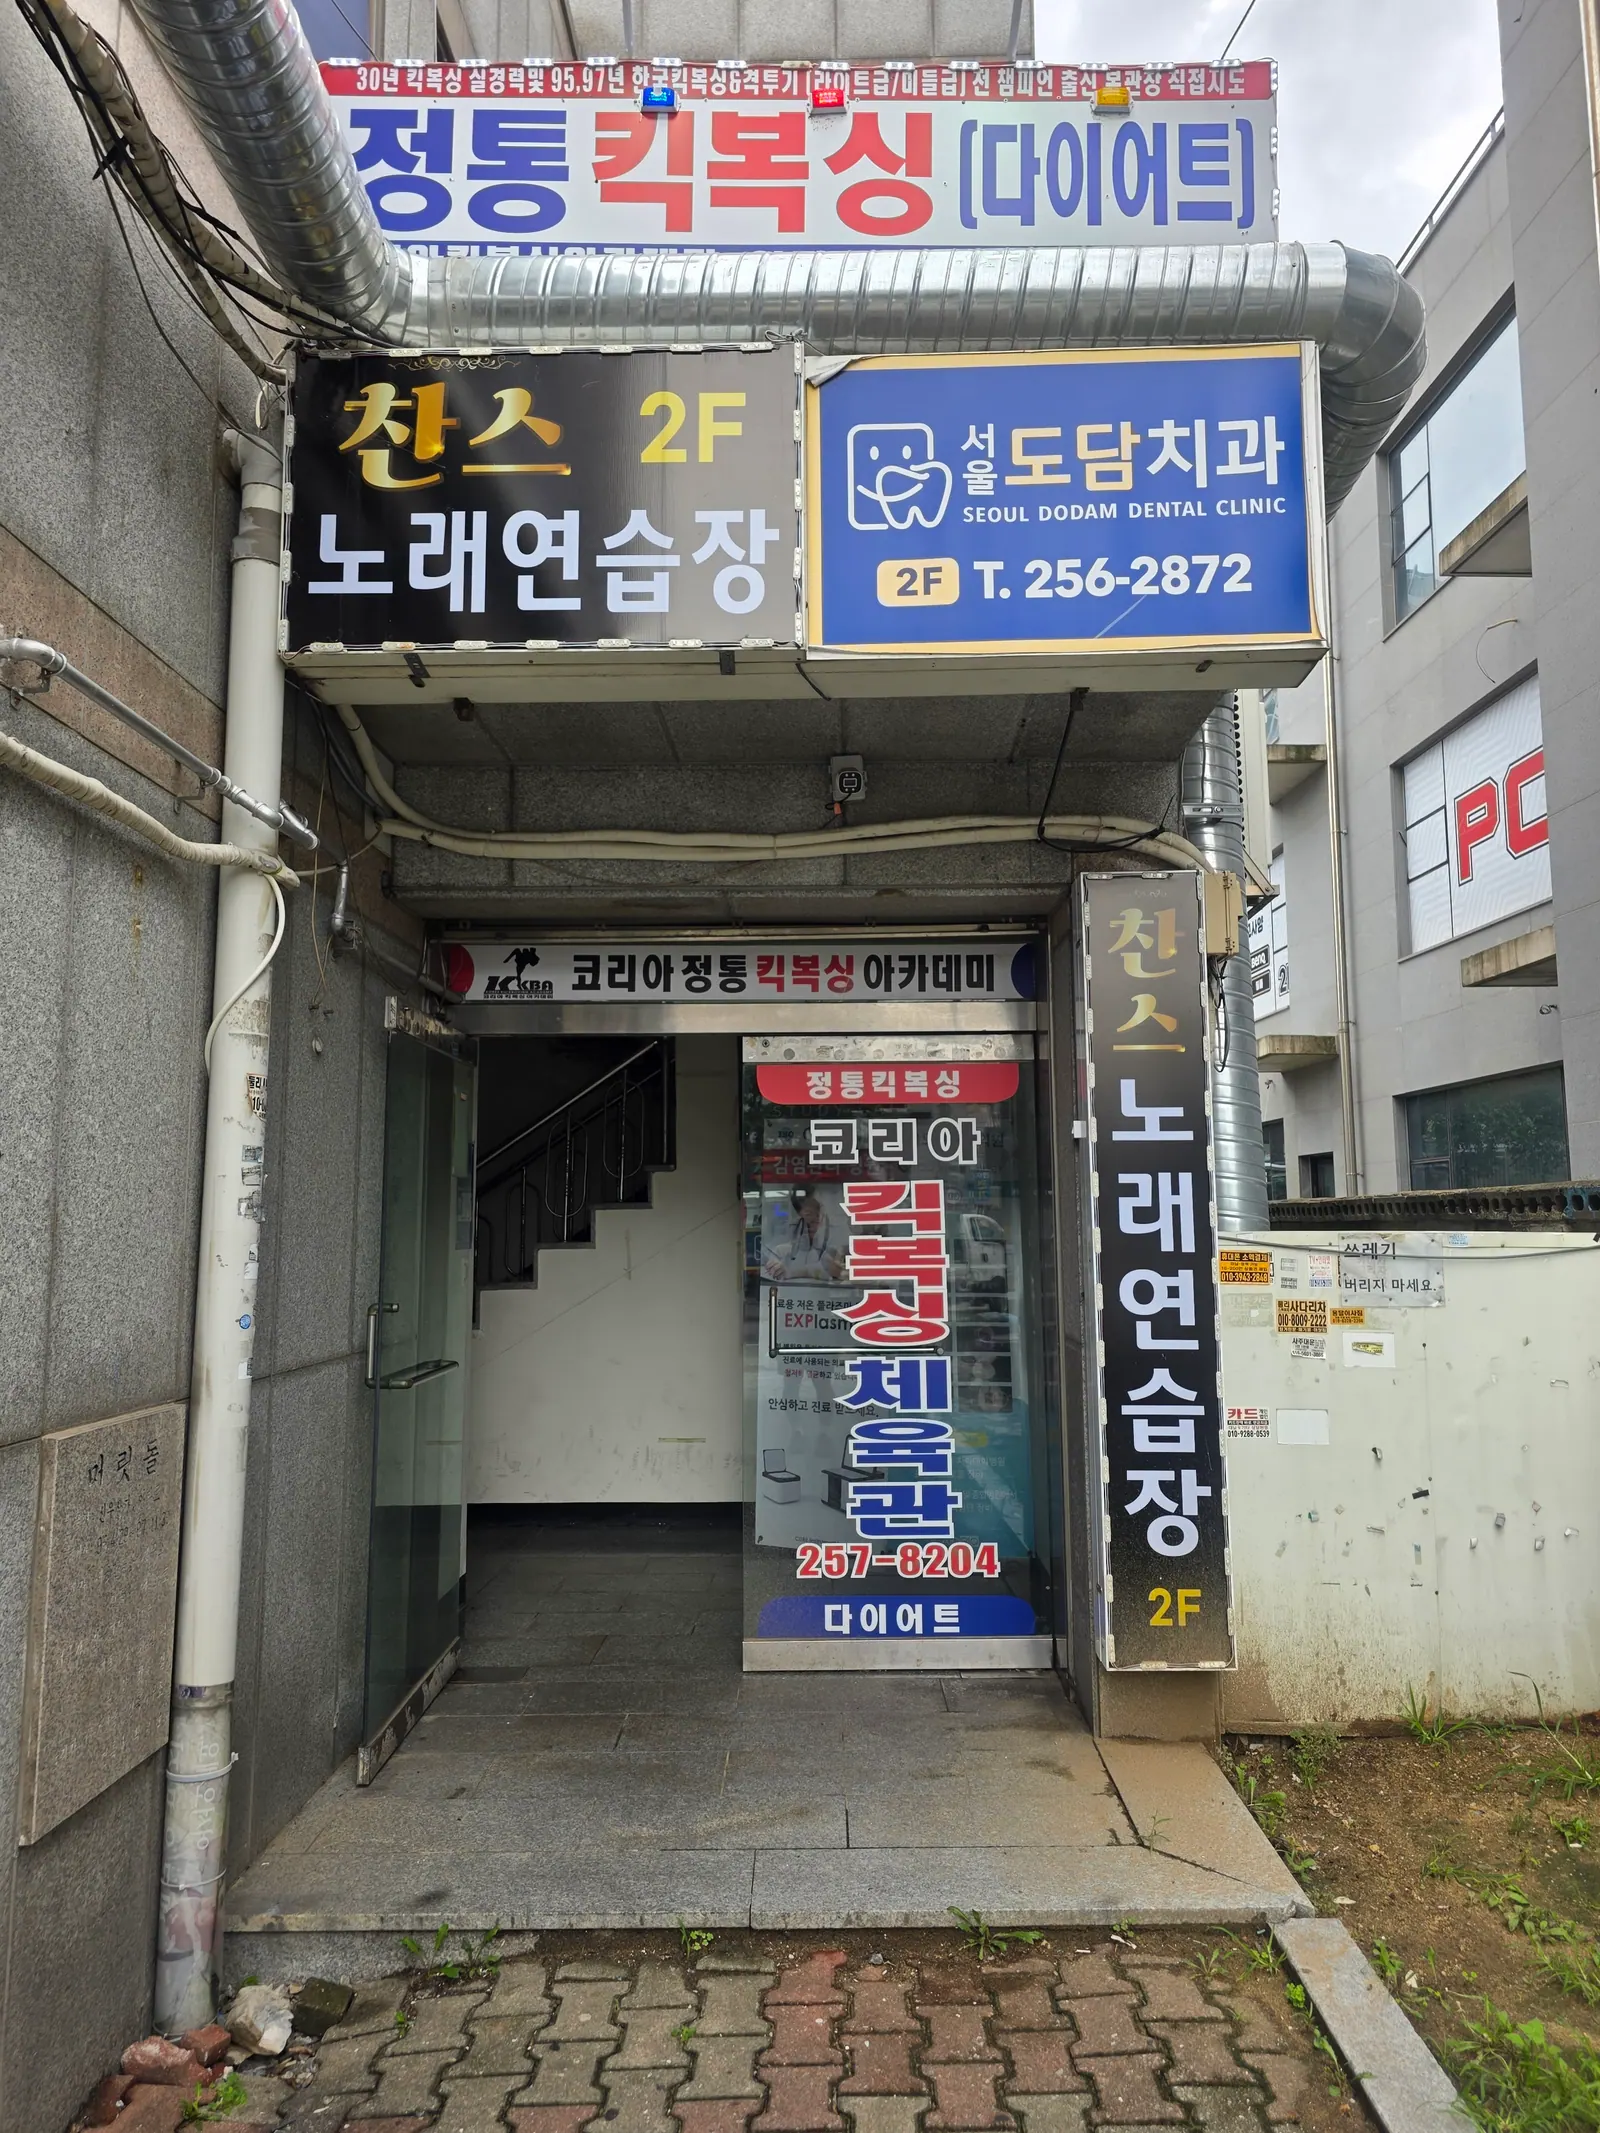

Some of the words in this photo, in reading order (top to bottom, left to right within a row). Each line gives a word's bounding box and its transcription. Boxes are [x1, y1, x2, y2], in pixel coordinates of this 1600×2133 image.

[356, 66, 399, 93] 30년
[406, 67, 462, 94] 킥복싱
[972, 68, 990, 96] 전
[997, 68, 1053, 97] 챔피언
[1060, 69, 1097, 97] 출신
[1167, 67, 1245, 96] 직접지도
[338, 381, 572, 491] 찬스
[639, 391, 747, 464] 2F
[1005, 416, 1286, 491] 도담치과
[963, 505, 1029, 524] SEOUL
[1038, 502, 1118, 522] DODAM
[1128, 500, 1208, 520] DENTAL
[1215, 496, 1287, 516] CLINIC
[308, 508, 780, 615] 노래연습장
[895, 565, 944, 598] 2F
[973, 561, 1011, 600] T.
[1023, 552, 1253, 599] 256-2872
[1107, 907, 1187, 1053] 찬스
[806, 1070, 961, 1100] 정통킥복싱
[808, 1117, 982, 1166] 코리아
[831, 1179, 951, 1347] 킥복싱
[1343, 1242, 1396, 1260] 쓰레기
[1344, 1278, 1386, 1293] 버리지
[1391, 1278, 1437, 1293] 마세요.
[797, 1299, 814, 1311] 저온
[1111, 1078, 1212, 1558] 노래연습장
[1277, 1313, 1327, 1327] 010-8009-2222
[1290, 1300, 1327, 1313] 사다리차
[768, 1398, 809, 1412] 안심하고
[811, 1401, 832, 1414] 진료
[1227, 1408, 1258, 1420] 카드
[832, 1355, 964, 1540] 체육관
[796, 1541, 1002, 1580] 257-8204
[823, 1602, 961, 1635] 다이어트
[1147, 1587, 1202, 1627] 2F
